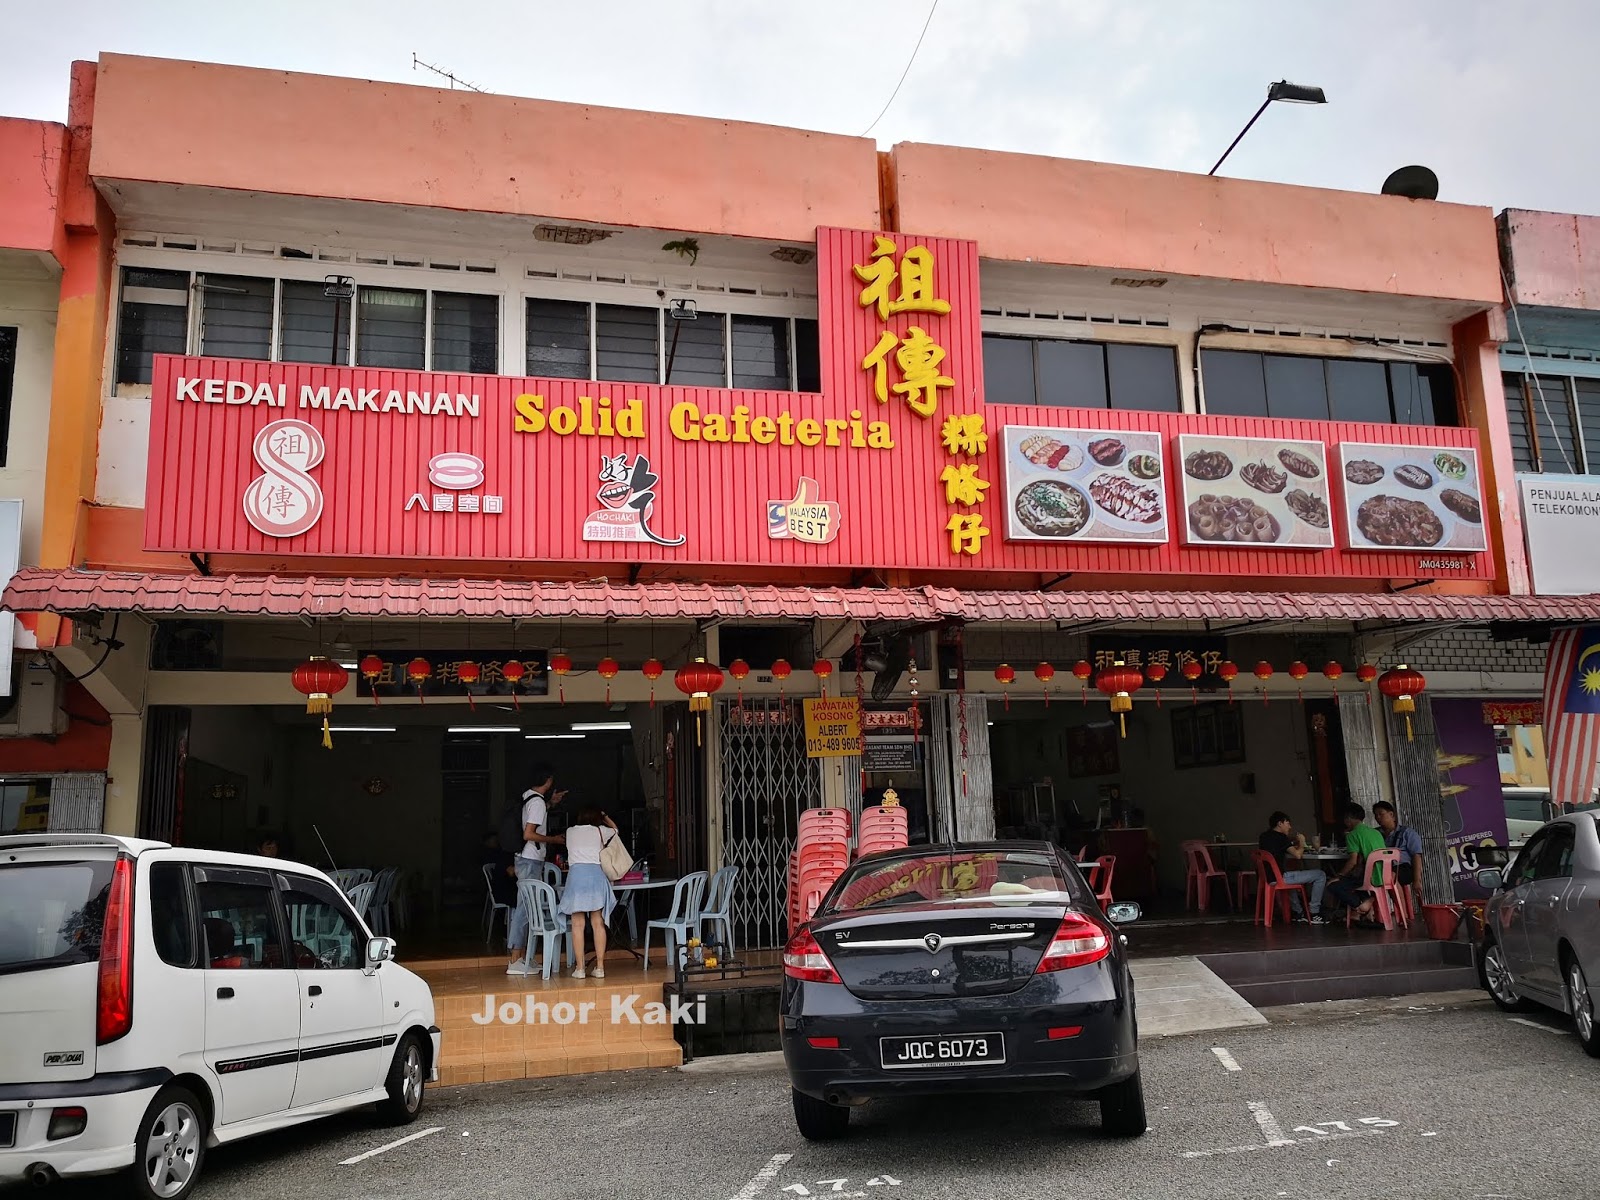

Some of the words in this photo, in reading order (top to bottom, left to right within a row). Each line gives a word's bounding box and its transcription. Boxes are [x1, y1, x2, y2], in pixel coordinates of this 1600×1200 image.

[176, 376, 287, 407] KEDAI
[299, 385, 480, 417] MAKANAN
[514, 393, 646, 438] Solid
[669, 401, 895, 449] Cafeteria
[1530, 488, 1580, 502] PENJUAL
[789, 505, 828, 521] MALAYSIA
[1531, 503, 1600, 517] TELEKOMON
[790, 518, 826, 539] BEST
[1418, 559, 1464, 570] JM0435981
[811, 701, 855, 712] JAWATAN
[812, 712, 854, 722] KOSONG
[818, 725, 848, 737] ALBERT
[808, 738, 840, 751] 013-489
[1461, 830, 1494, 843] TEMPERED
[835, 932, 851, 940] SV
[898, 1042, 935, 1061] JQC
[938, 1038, 989, 1059] 6073
